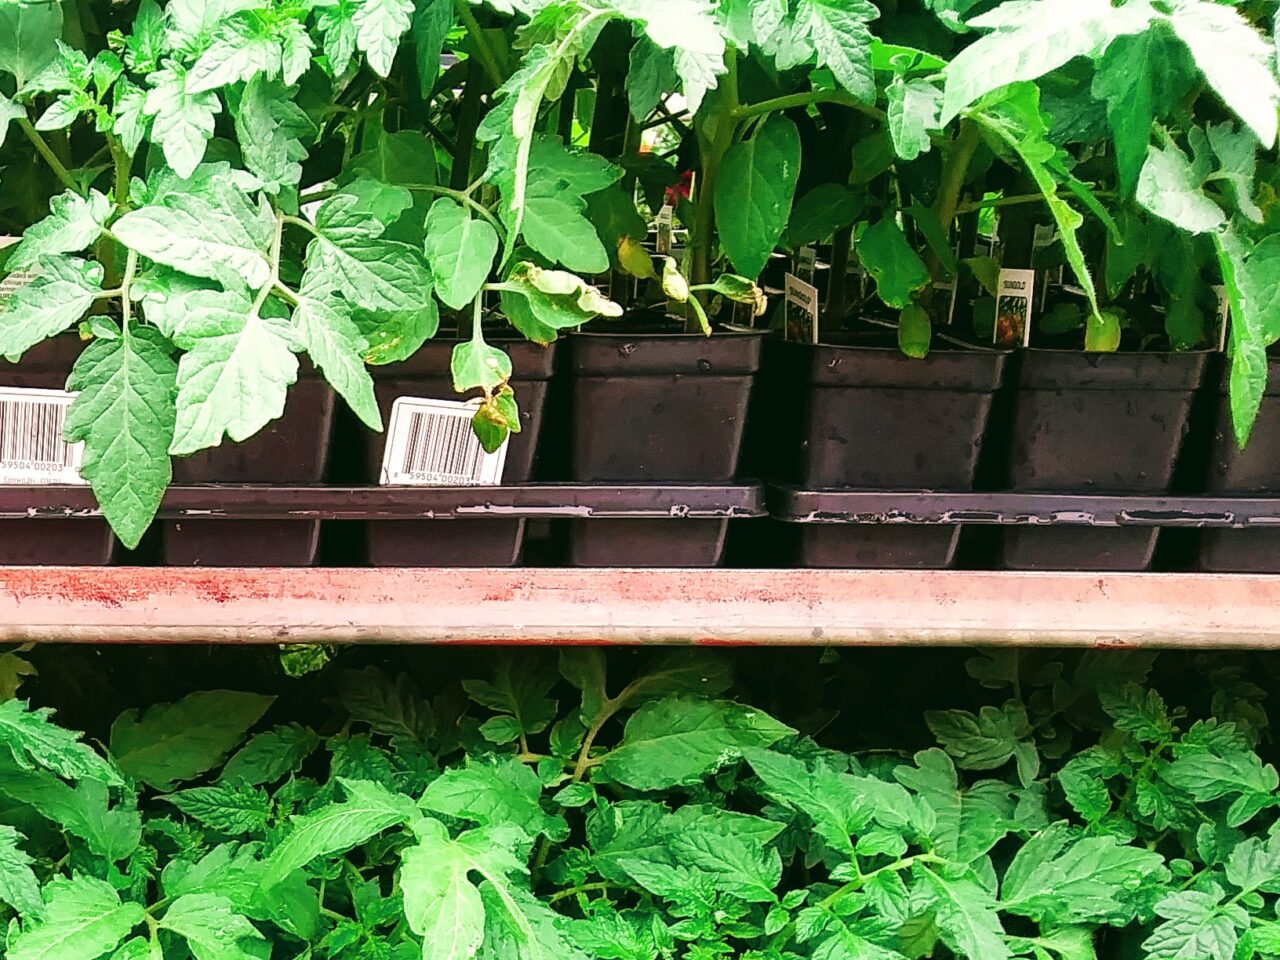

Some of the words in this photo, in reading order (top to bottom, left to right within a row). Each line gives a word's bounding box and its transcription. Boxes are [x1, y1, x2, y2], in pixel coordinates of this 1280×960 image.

[1, 461, 31, 470] 59504
[33, 462, 63, 472] 00203
[409, 472, 438, 481] 59504
[441, 474, 470, 485] 00203
